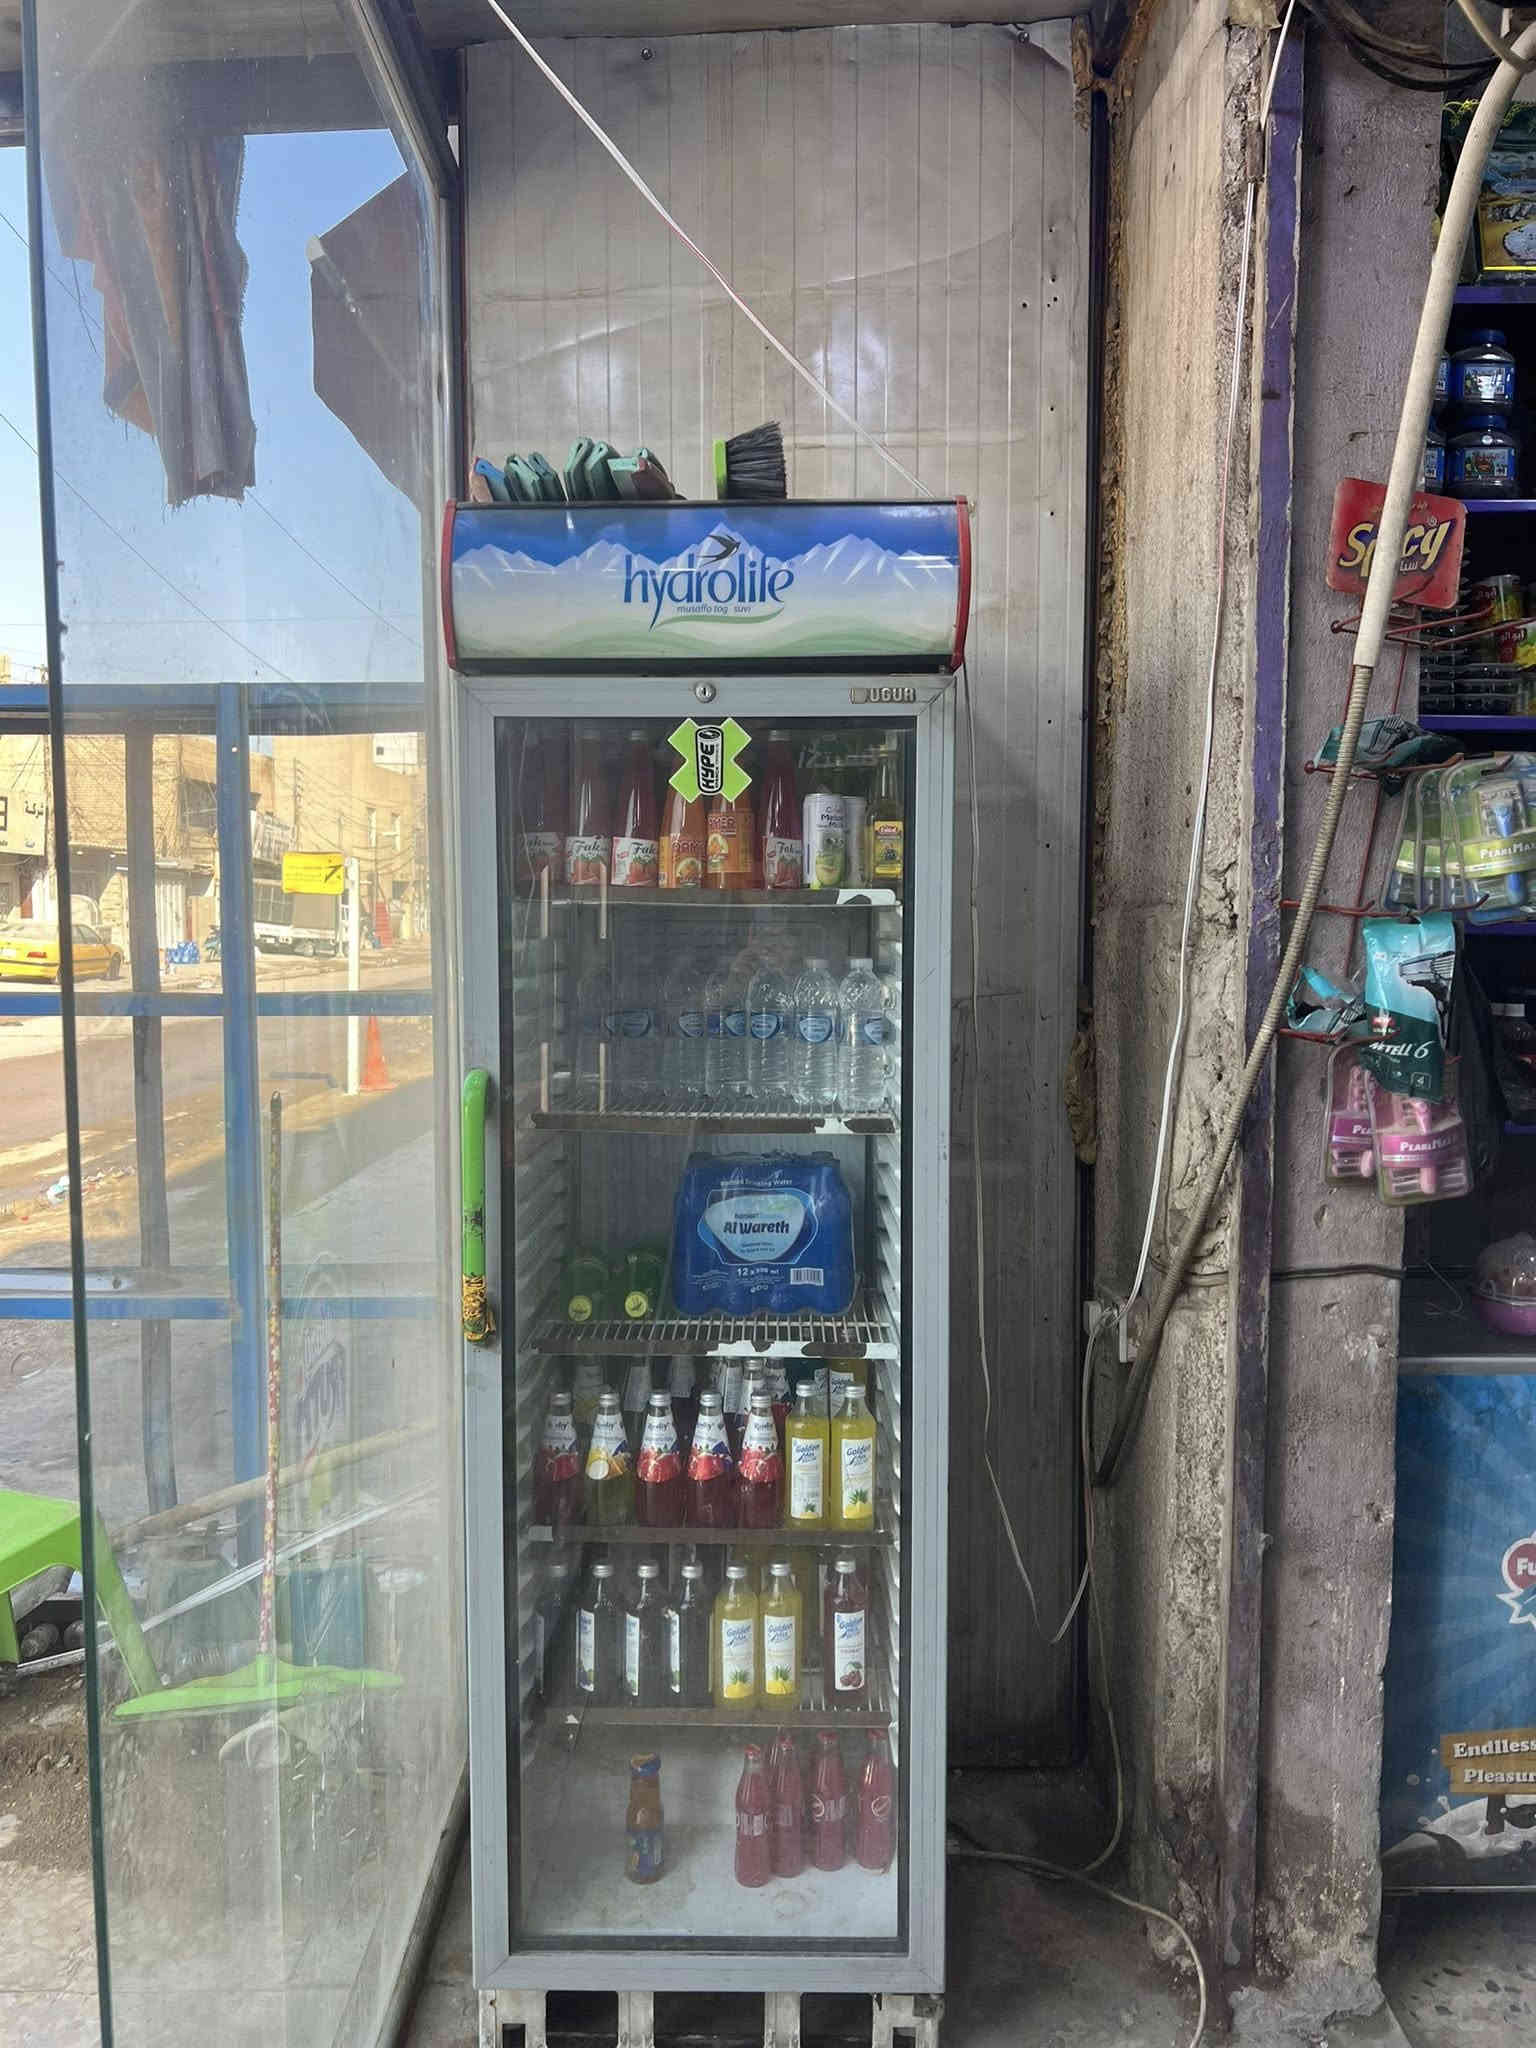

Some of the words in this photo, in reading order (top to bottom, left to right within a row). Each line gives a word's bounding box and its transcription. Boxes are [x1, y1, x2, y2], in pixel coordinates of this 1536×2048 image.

[1338, 519, 1452, 577] Spcy
[623, 553, 794, 632] hydrolife
[700, 742, 715, 789] HYPE
[1413, 1040, 1436, 1059] 6
[739, 1220, 790, 1235] Wareth
